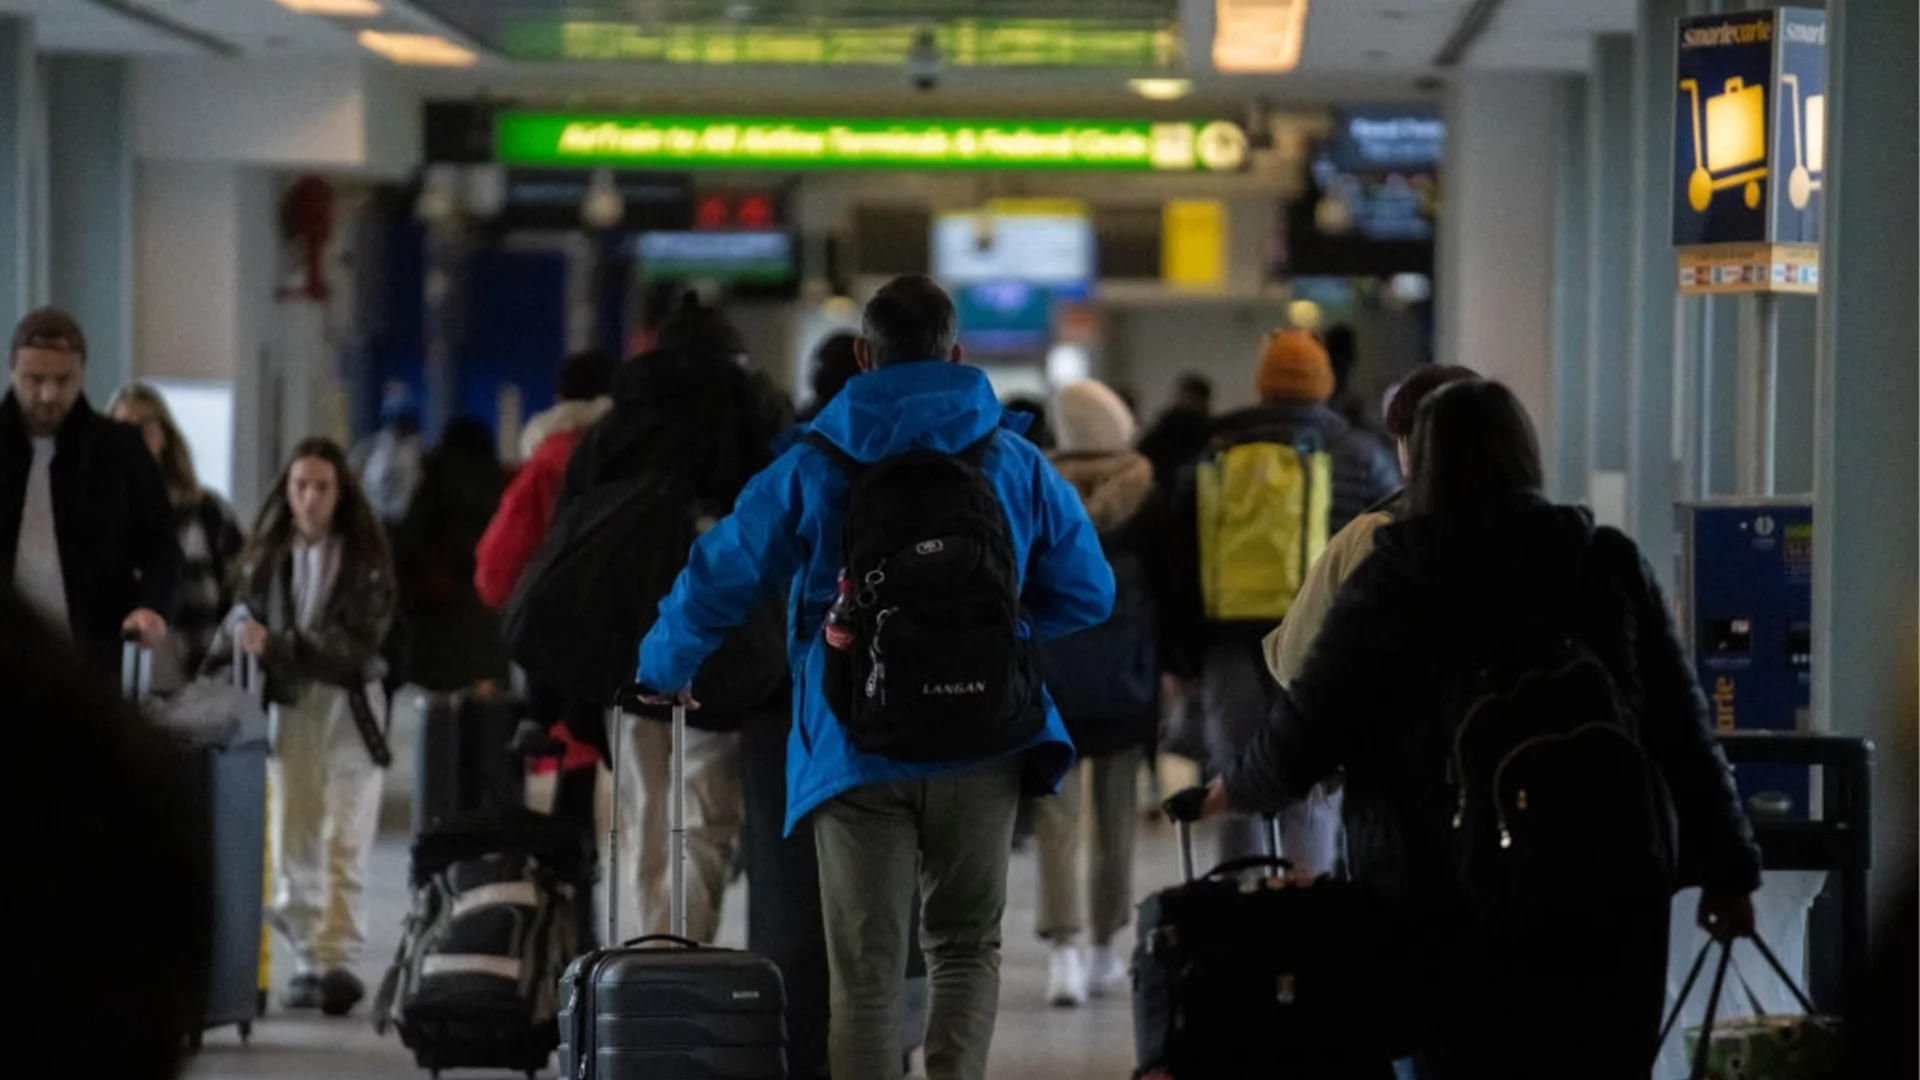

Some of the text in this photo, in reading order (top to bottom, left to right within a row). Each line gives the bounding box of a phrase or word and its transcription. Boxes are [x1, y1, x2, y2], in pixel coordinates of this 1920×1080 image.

[665, 125, 697, 156] to
[697, 124, 738, 156] All
[828, 126, 949, 158] Terminals
[921, 680, 986, 695] LANGAN
